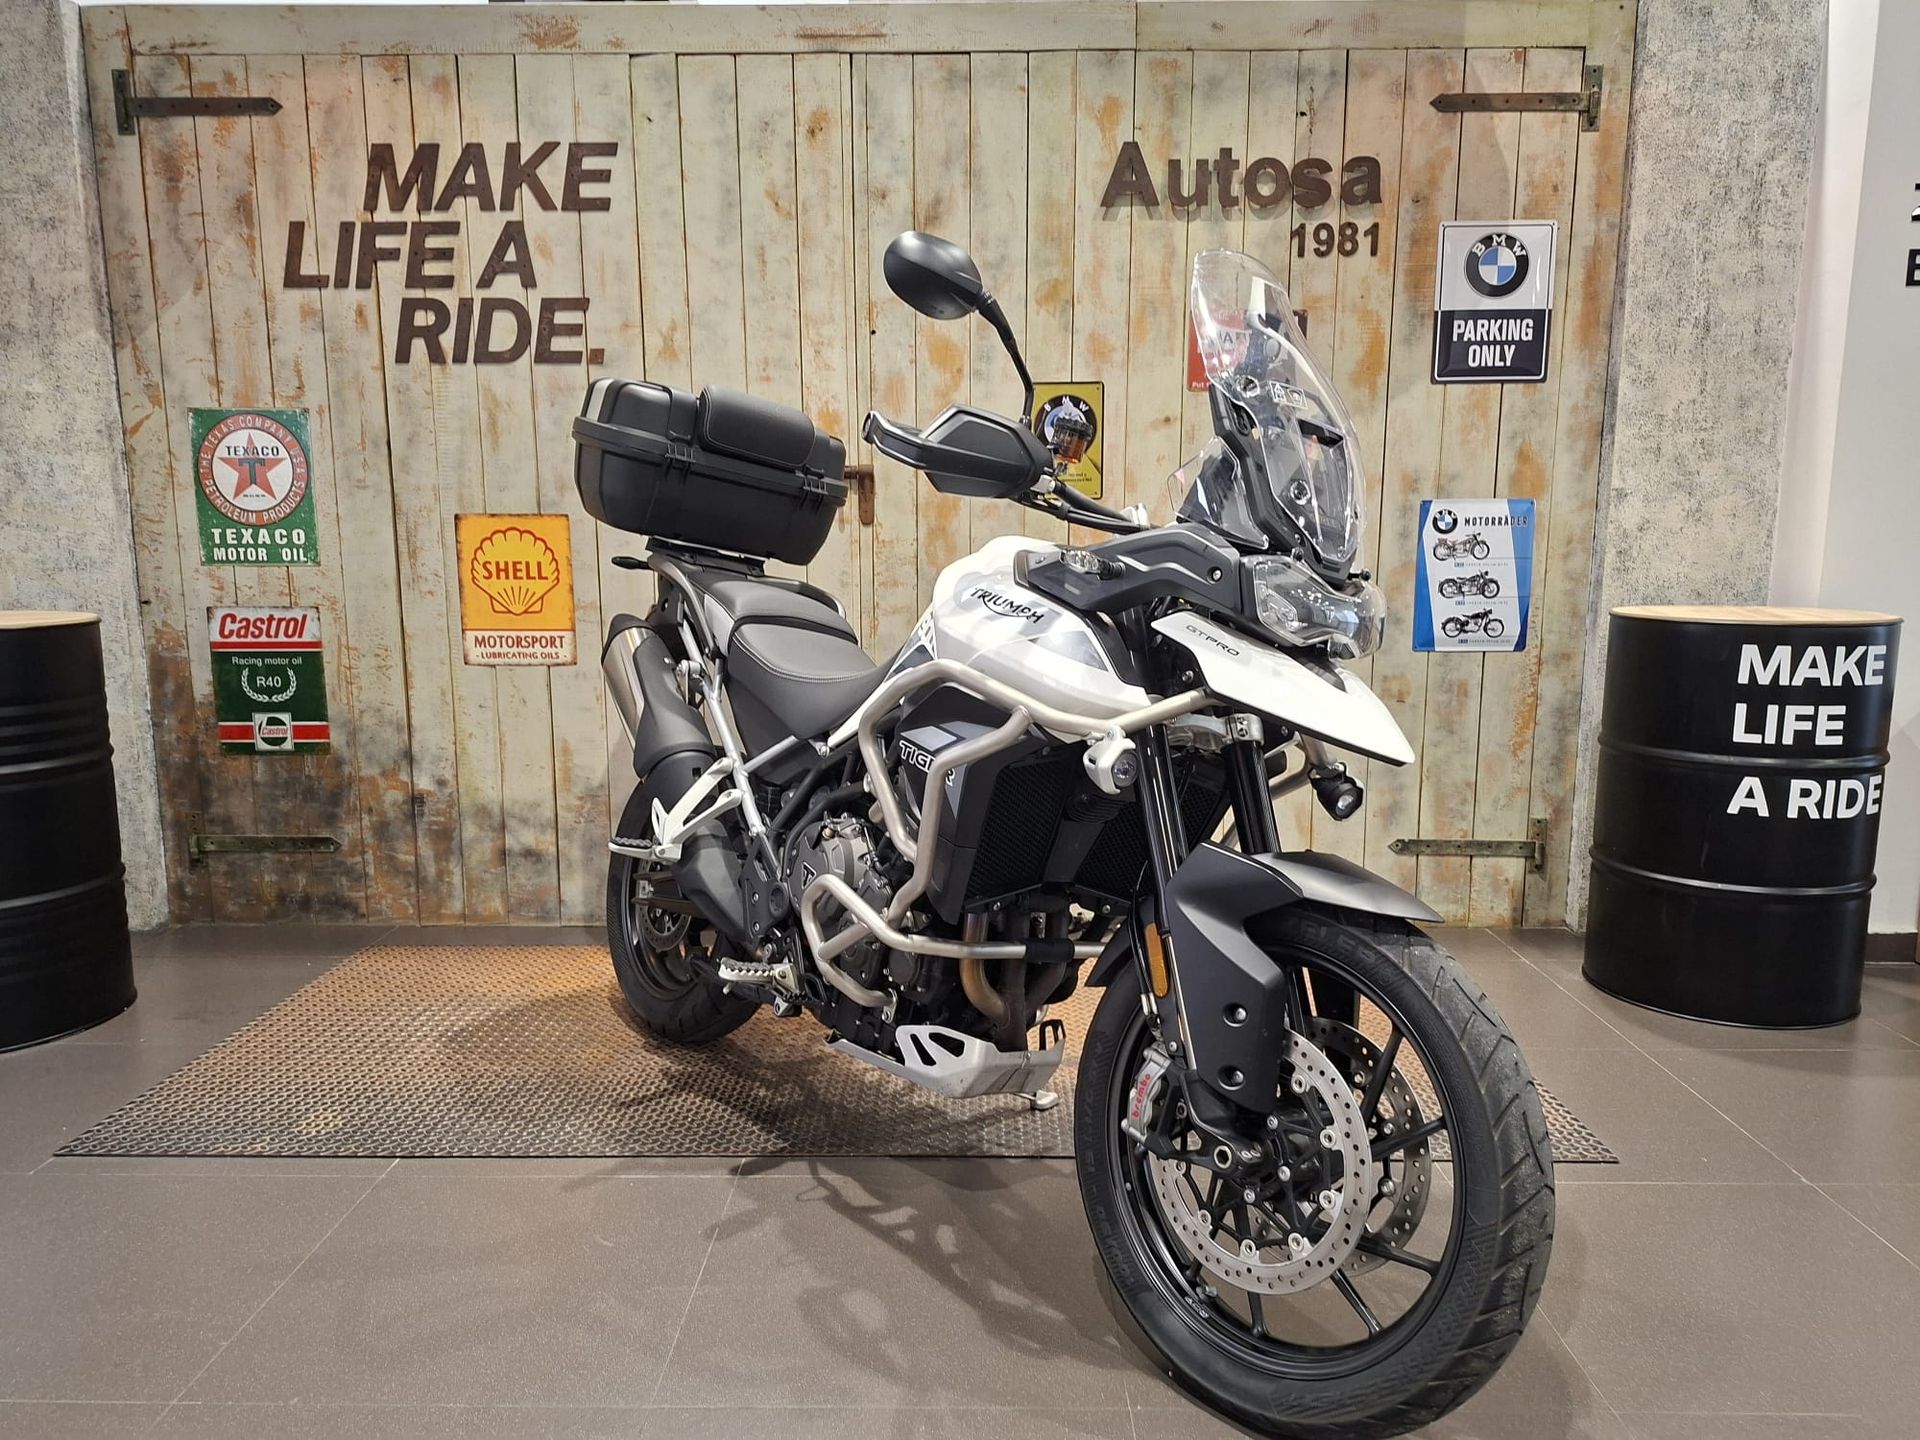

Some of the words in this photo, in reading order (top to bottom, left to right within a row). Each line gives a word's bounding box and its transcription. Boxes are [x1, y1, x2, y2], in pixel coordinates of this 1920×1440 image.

[363, 141, 618, 212] MAKE
[1100, 141, 1383, 208] Autosa
[1290, 222, 1380, 258] 1981
[1472, 233, 1527, 257] BMW
[283, 221, 460, 289] LIFE
[476, 221, 537, 289] A
[395, 297, 605, 364] RIDE.
[1452, 318, 1534, 342] PARKING
[1467, 344, 1516, 367] ONLY
[205, 420, 235, 448] TEXAS
[239, 416, 292, 443] COMPANY
[226, 445, 279, 457] TEXACO
[205, 479, 256, 523] PETROLEUM
[262, 480, 305, 522] PRODUCTS
[211, 528, 306, 544] TEXACO
[213, 548, 267, 561] MOTOR
[282, 547, 307, 561] OIL
[482, 560, 548, 580] SHELL
[970, 588, 1045, 624] TRIUMPH
[218, 613, 308, 639] Castrol
[474, 635, 565, 648] MOTORSPORT
[231, 656, 262, 666] Racing
[264, 657, 289, 665] motor
[292, 656, 302, 665] oil
[481, 652, 538, 660] LUBRICATING
[541, 652, 560, 660] OILS
[1737, 644, 1887, 686] MAKE
[256, 676, 281, 688] R40
[261, 727, 288, 735] Castrol
[1732, 703, 1847, 745] LIFE
[1726, 776, 1770, 817] A
[1786, 774, 1883, 819] RIDE
[1131, 1073, 1152, 1118] brembo
